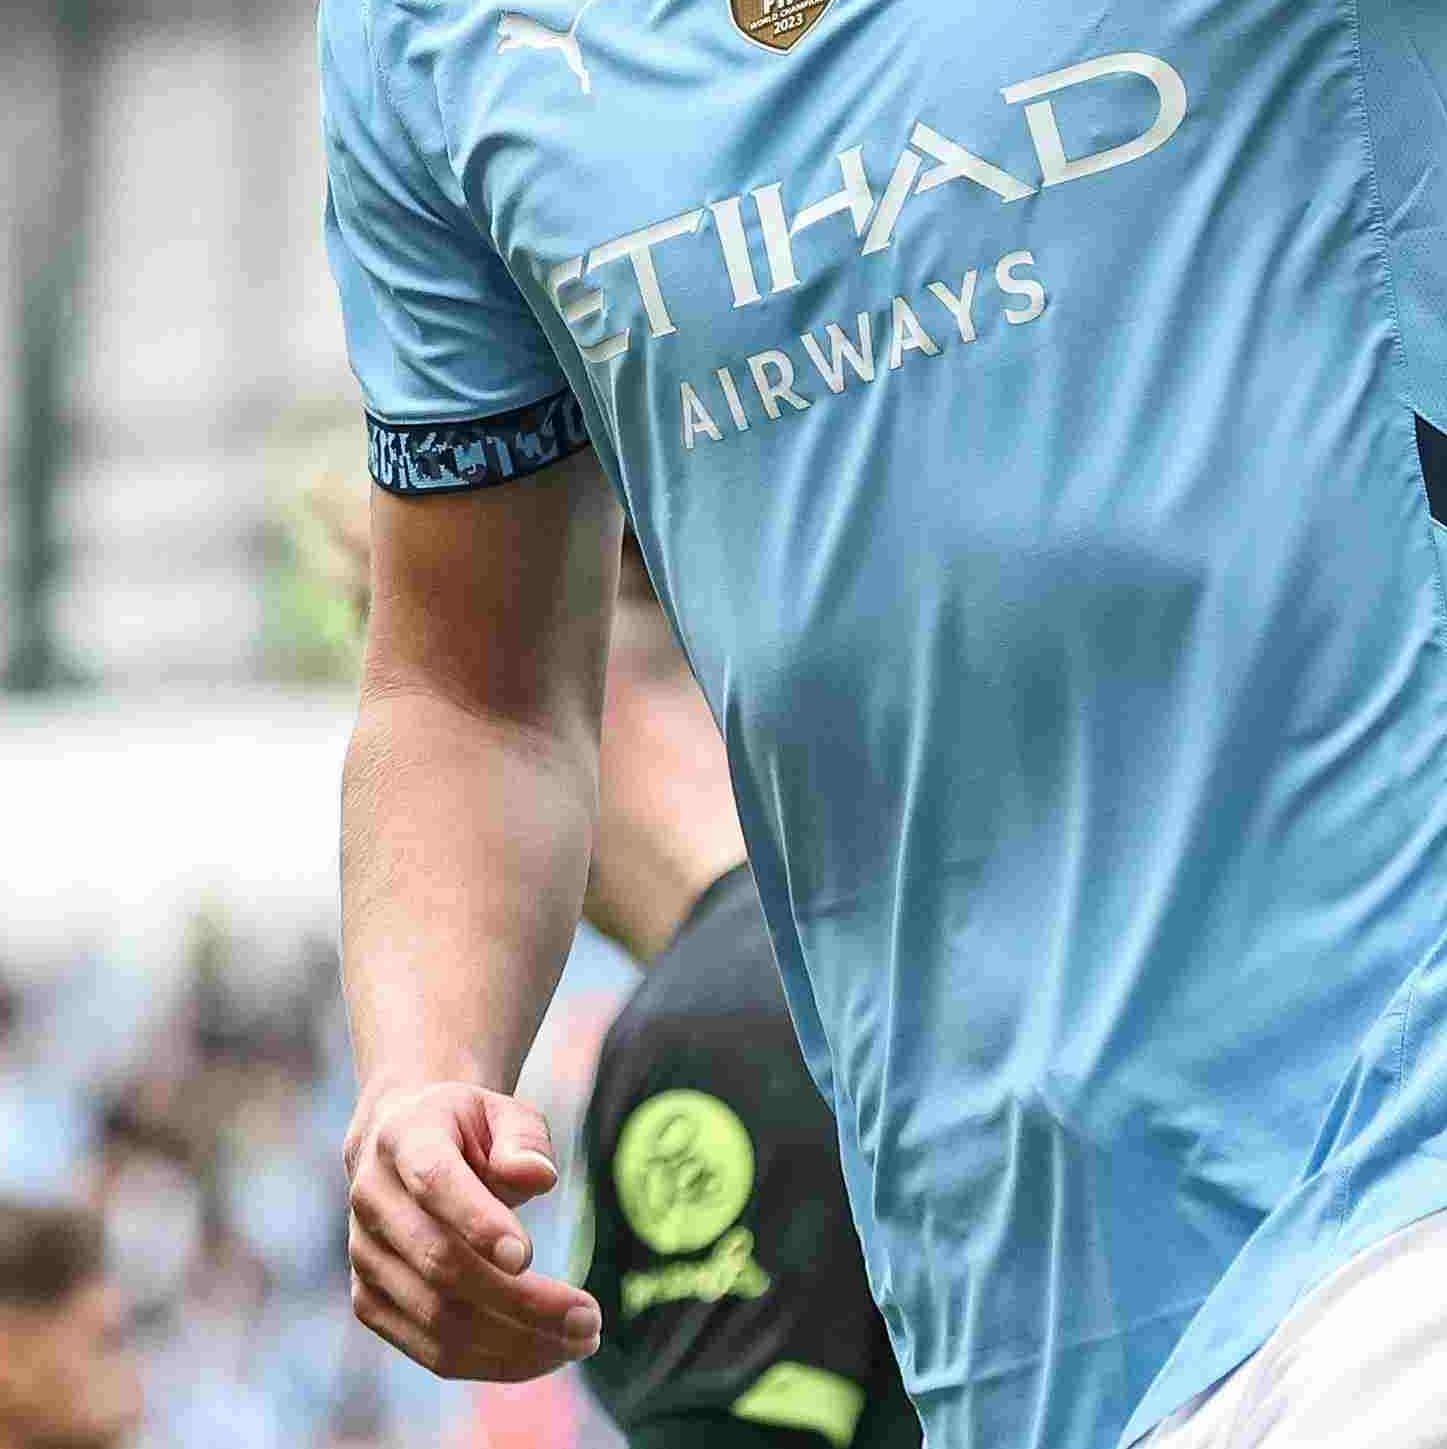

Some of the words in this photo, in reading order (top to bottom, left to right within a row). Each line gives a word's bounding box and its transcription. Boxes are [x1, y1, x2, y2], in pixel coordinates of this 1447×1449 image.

[774, 13, 804, 34] 2023
[554, 51, 1188, 363] ETIHAD
[678, 250, 1048, 449] AIRWAYS
